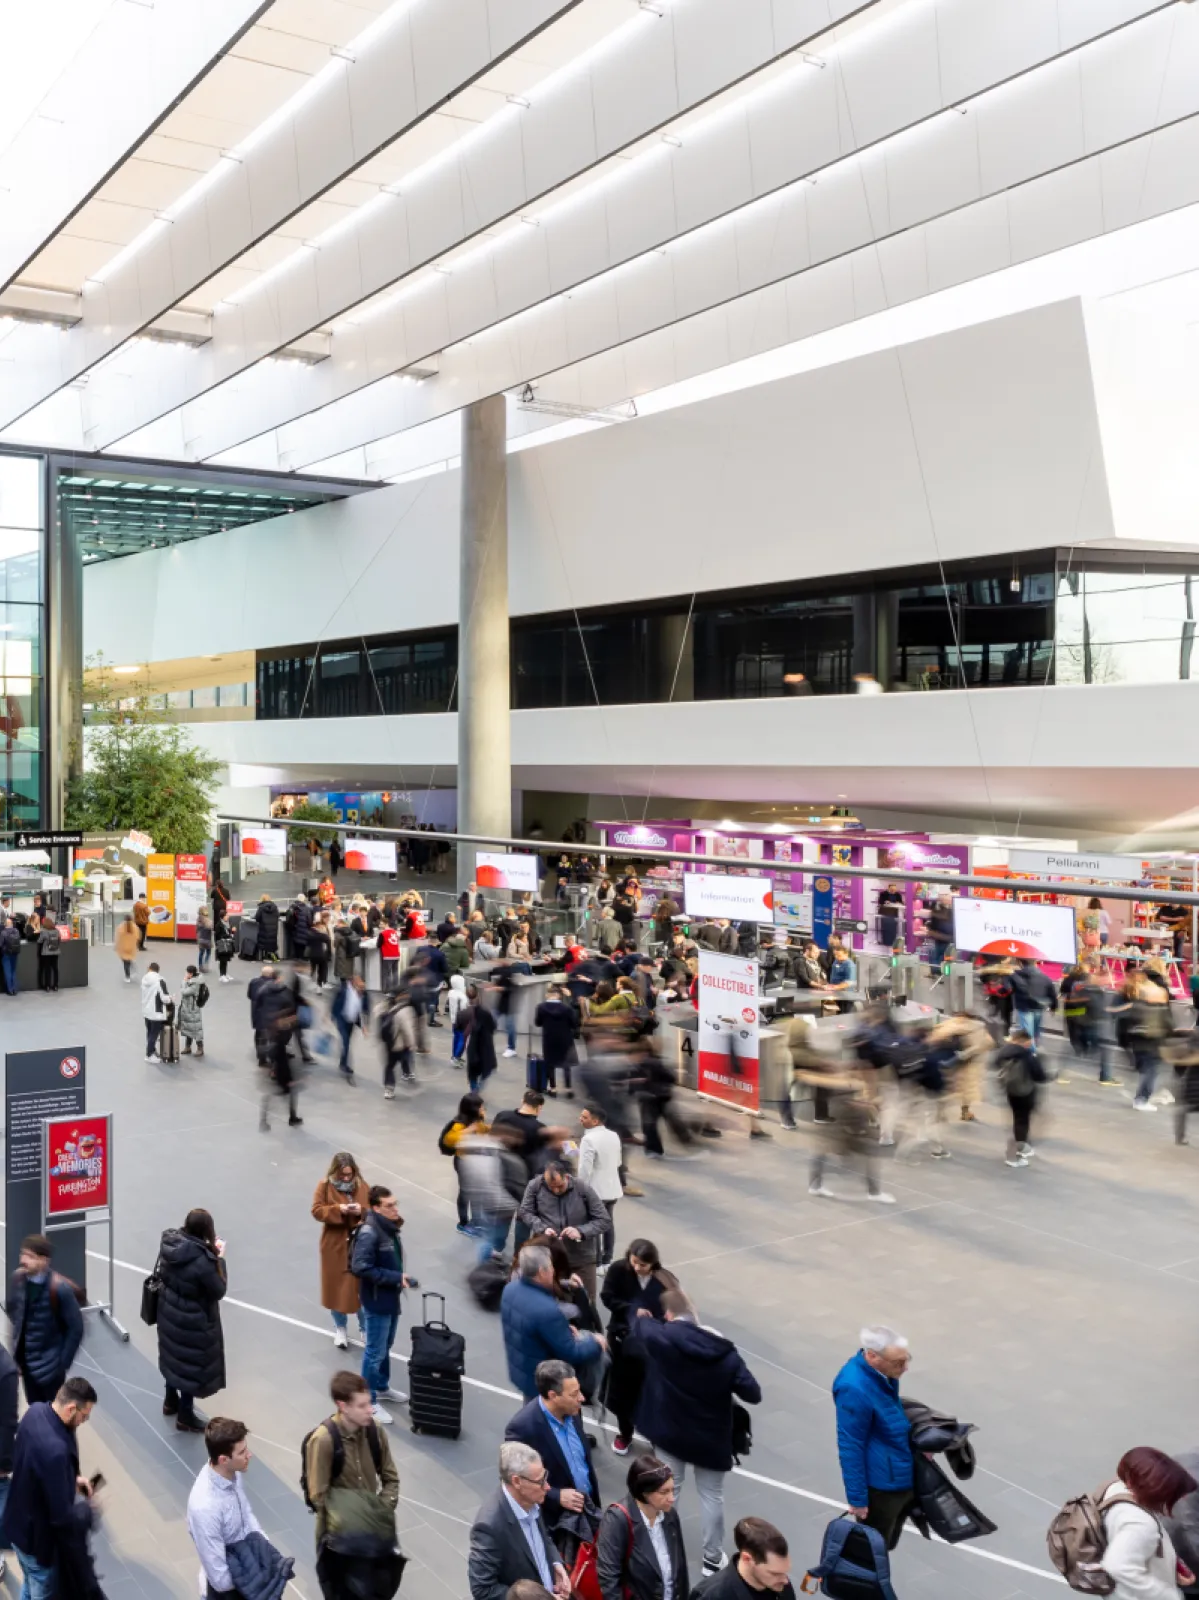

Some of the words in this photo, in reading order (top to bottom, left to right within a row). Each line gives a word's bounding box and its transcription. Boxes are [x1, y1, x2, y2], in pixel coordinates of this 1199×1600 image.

[29, 836, 51, 844] Service
[1046, 856, 1100, 870] Pellianni
[700, 891, 755, 904] Information
[983, 922, 1008, 934] Fast
[1011, 924, 1043, 938] Lane
[702, 974, 755, 997] COLLECTIBLE
[681, 1036, 694, 1058] 4
[57, 1157, 103, 1174] MEMORIES
